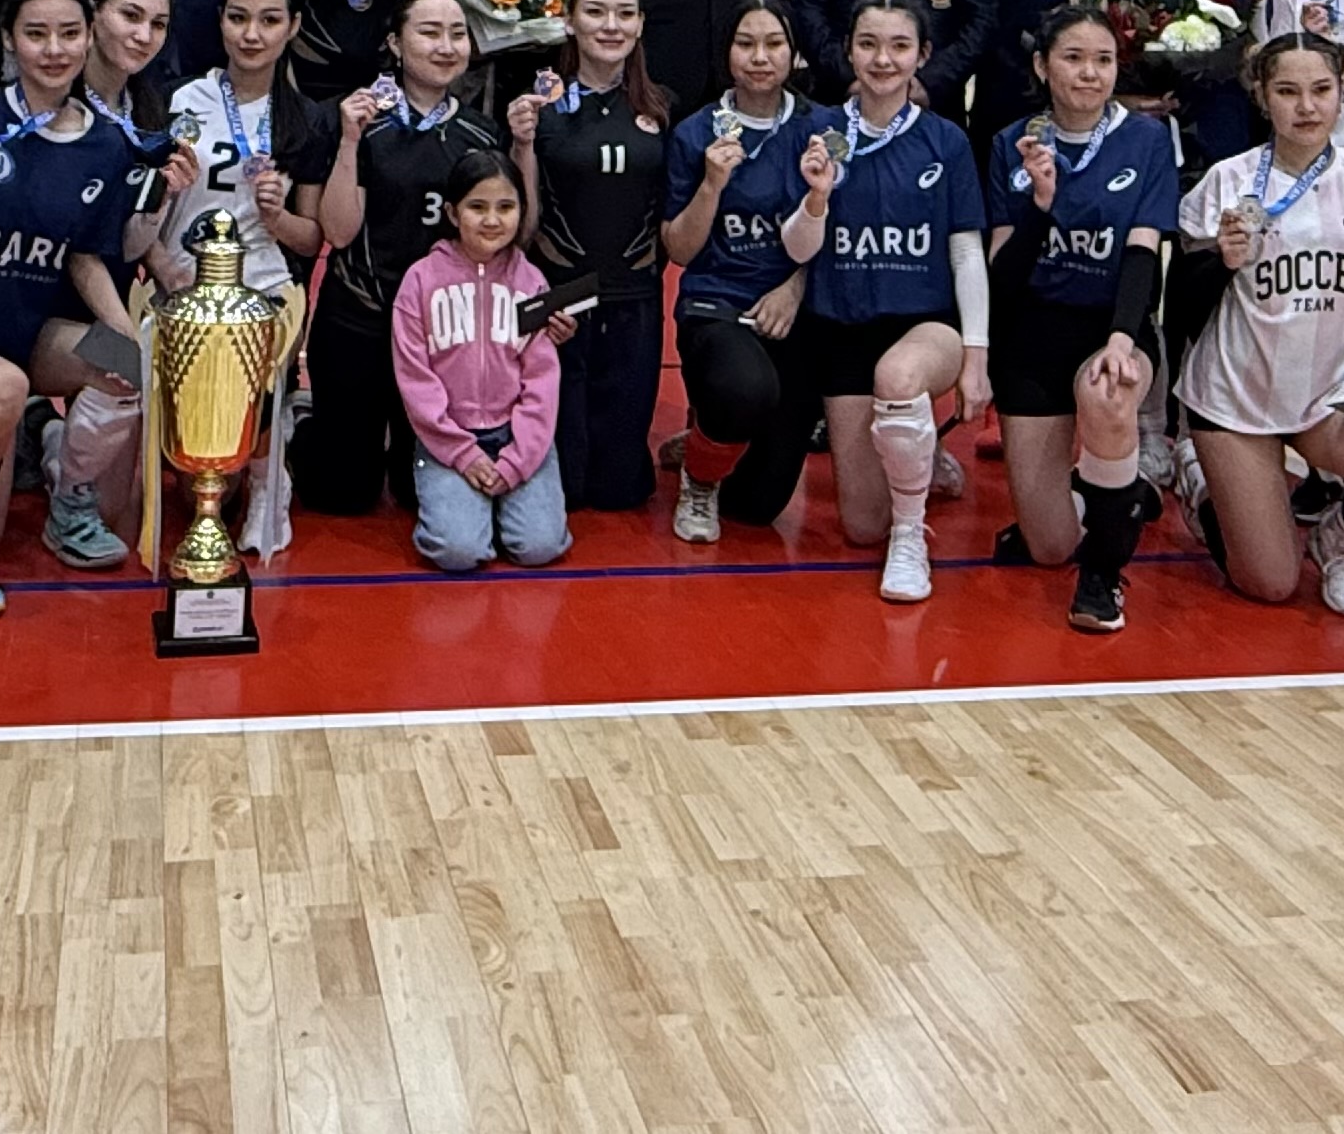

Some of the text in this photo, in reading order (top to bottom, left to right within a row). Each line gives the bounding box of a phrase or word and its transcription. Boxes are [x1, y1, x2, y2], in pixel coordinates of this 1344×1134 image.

[207, 140, 240, 193] 2
[600, 144, 626, 174] 11
[420, 191, 443, 226] 3
[1293, 296, 1336, 313] TEAM
